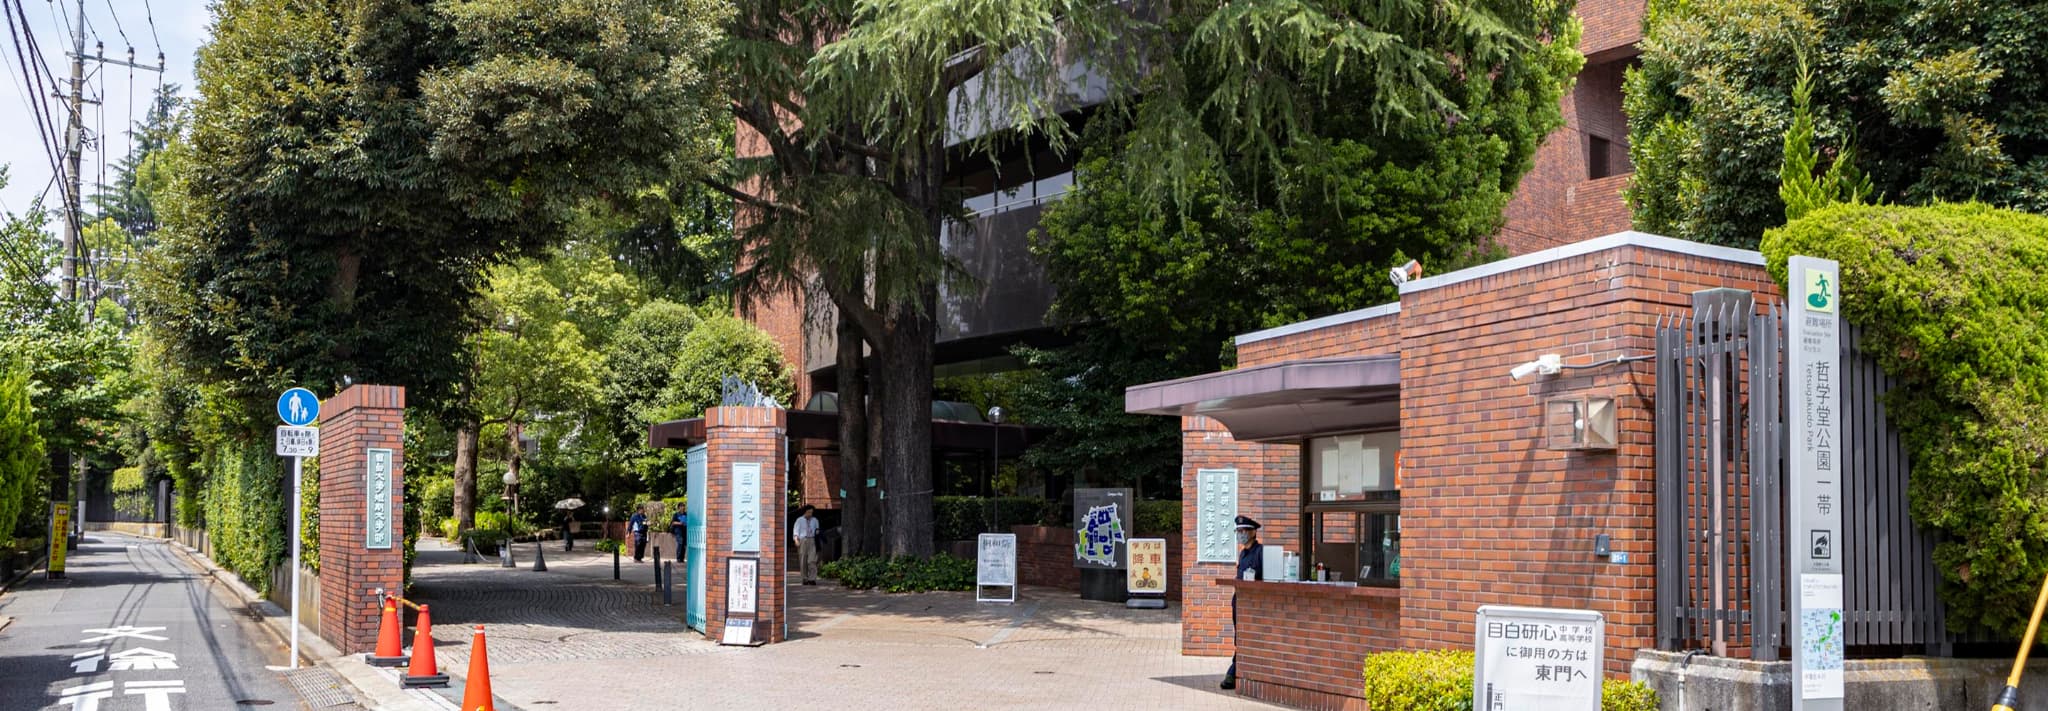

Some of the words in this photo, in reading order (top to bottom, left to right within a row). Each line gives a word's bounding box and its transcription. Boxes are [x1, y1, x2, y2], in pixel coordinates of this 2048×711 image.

[1806, 363, 1815, 429] Tetsugakudo
[1807, 430, 1815, 453] Park
[1131, 542, 1161, 551] 学内は
[1132, 553, 1161, 567] 降車
[1488, 622, 1557, 641] 目白研心
[1559, 625, 1593, 634] 中学校
[1559, 634, 1593, 643] 高等学校
[1506, 646, 1588, 662] に御用の方は
[1535, 664, 1588, 683] 東門へ
[1493, 692, 1503, 711] 正門
